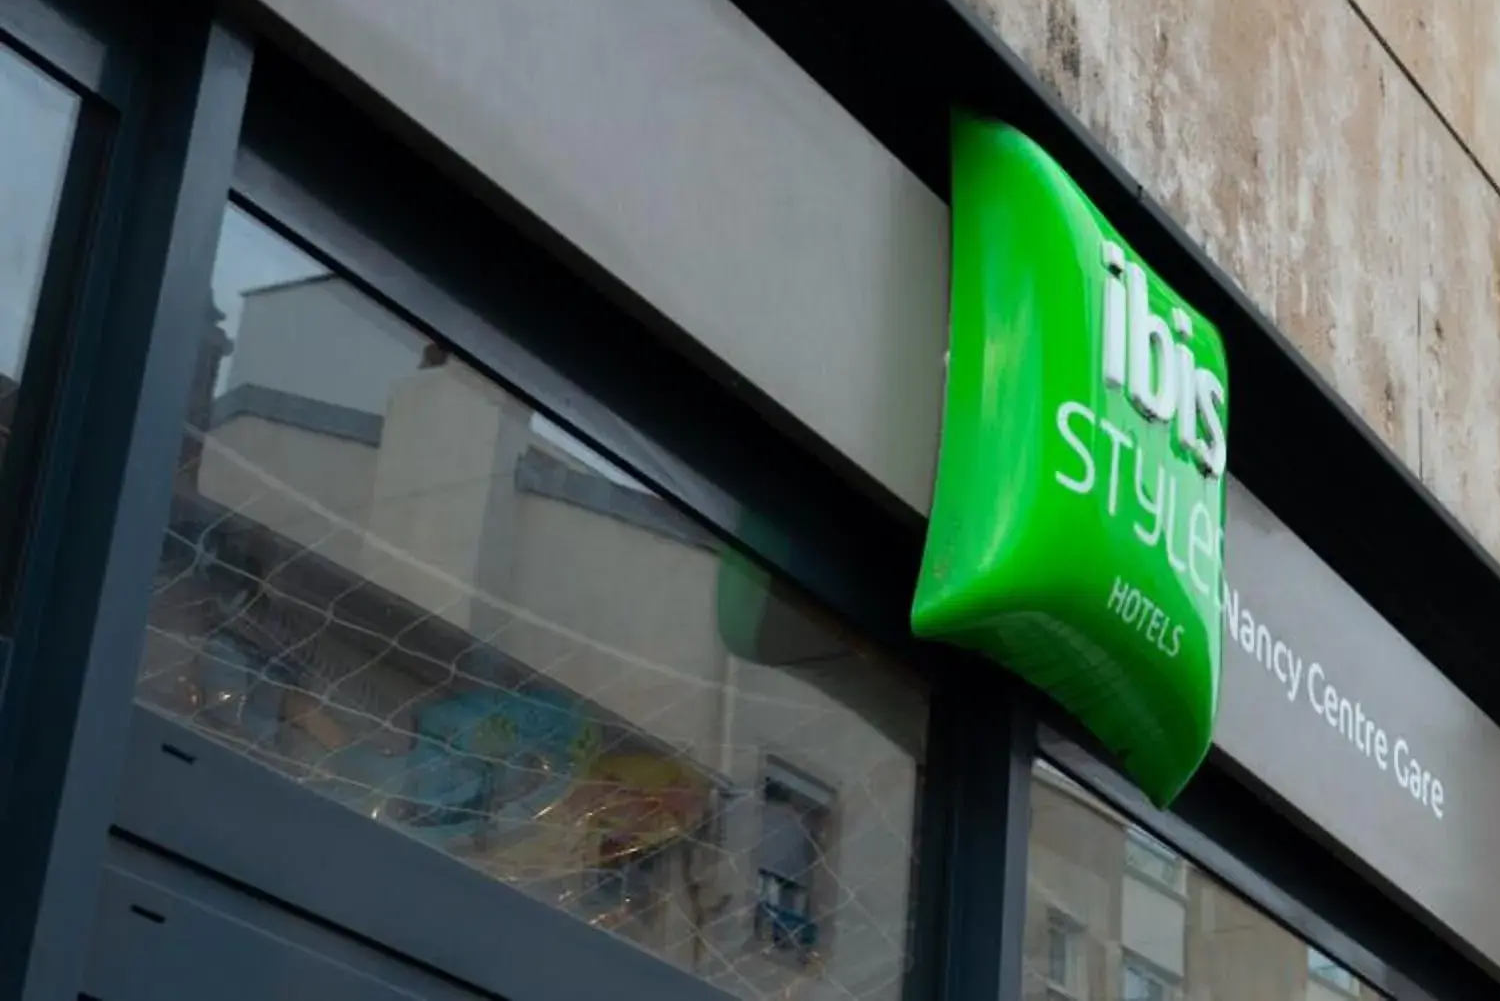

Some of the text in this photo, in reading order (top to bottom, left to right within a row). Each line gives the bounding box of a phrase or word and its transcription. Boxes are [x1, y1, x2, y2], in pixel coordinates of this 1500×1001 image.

[1102, 240, 1227, 480] ibis
[1107, 576, 1185, 657] HOTELS
[1222, 580, 1444, 819] Nancy Centre Gare
